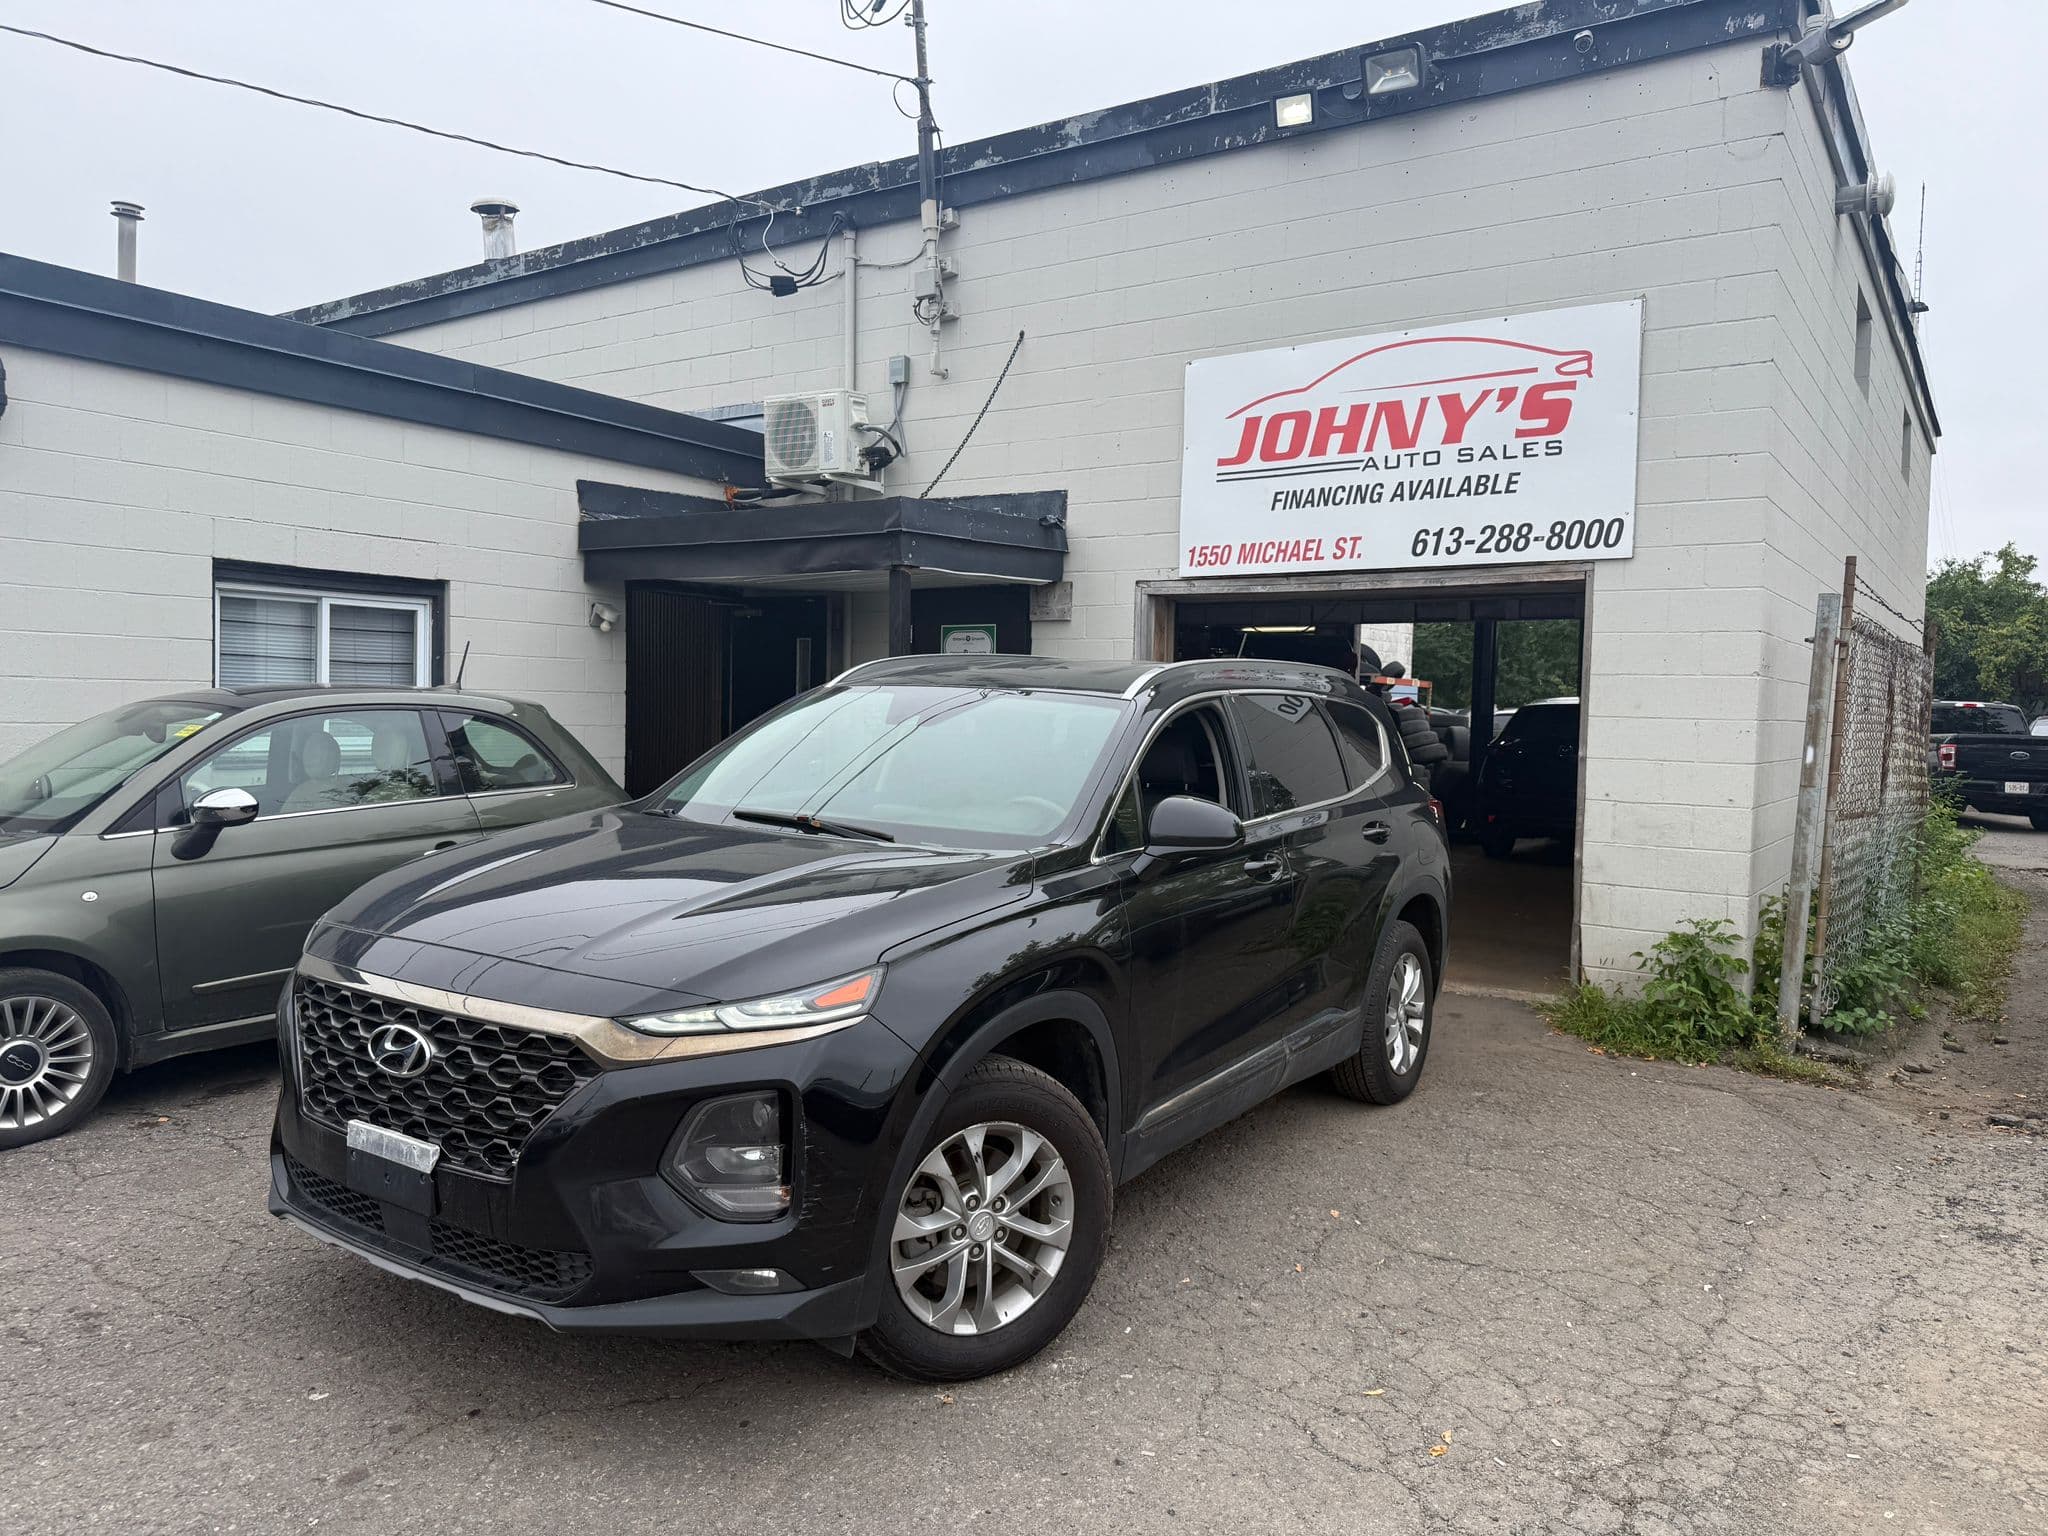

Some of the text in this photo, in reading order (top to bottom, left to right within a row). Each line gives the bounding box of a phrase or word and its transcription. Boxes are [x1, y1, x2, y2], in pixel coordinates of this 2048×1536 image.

[1217, 381, 1576, 466] JOHNY'S
[1360, 440, 1563, 471] AUTO SALES
[1272, 472, 1521, 511] FINANCING AVAILABLE
[1188, 536, 1363, 568] 1550 MICHAEL ST.
[1411, 518, 1625, 557] 613-288-8000
